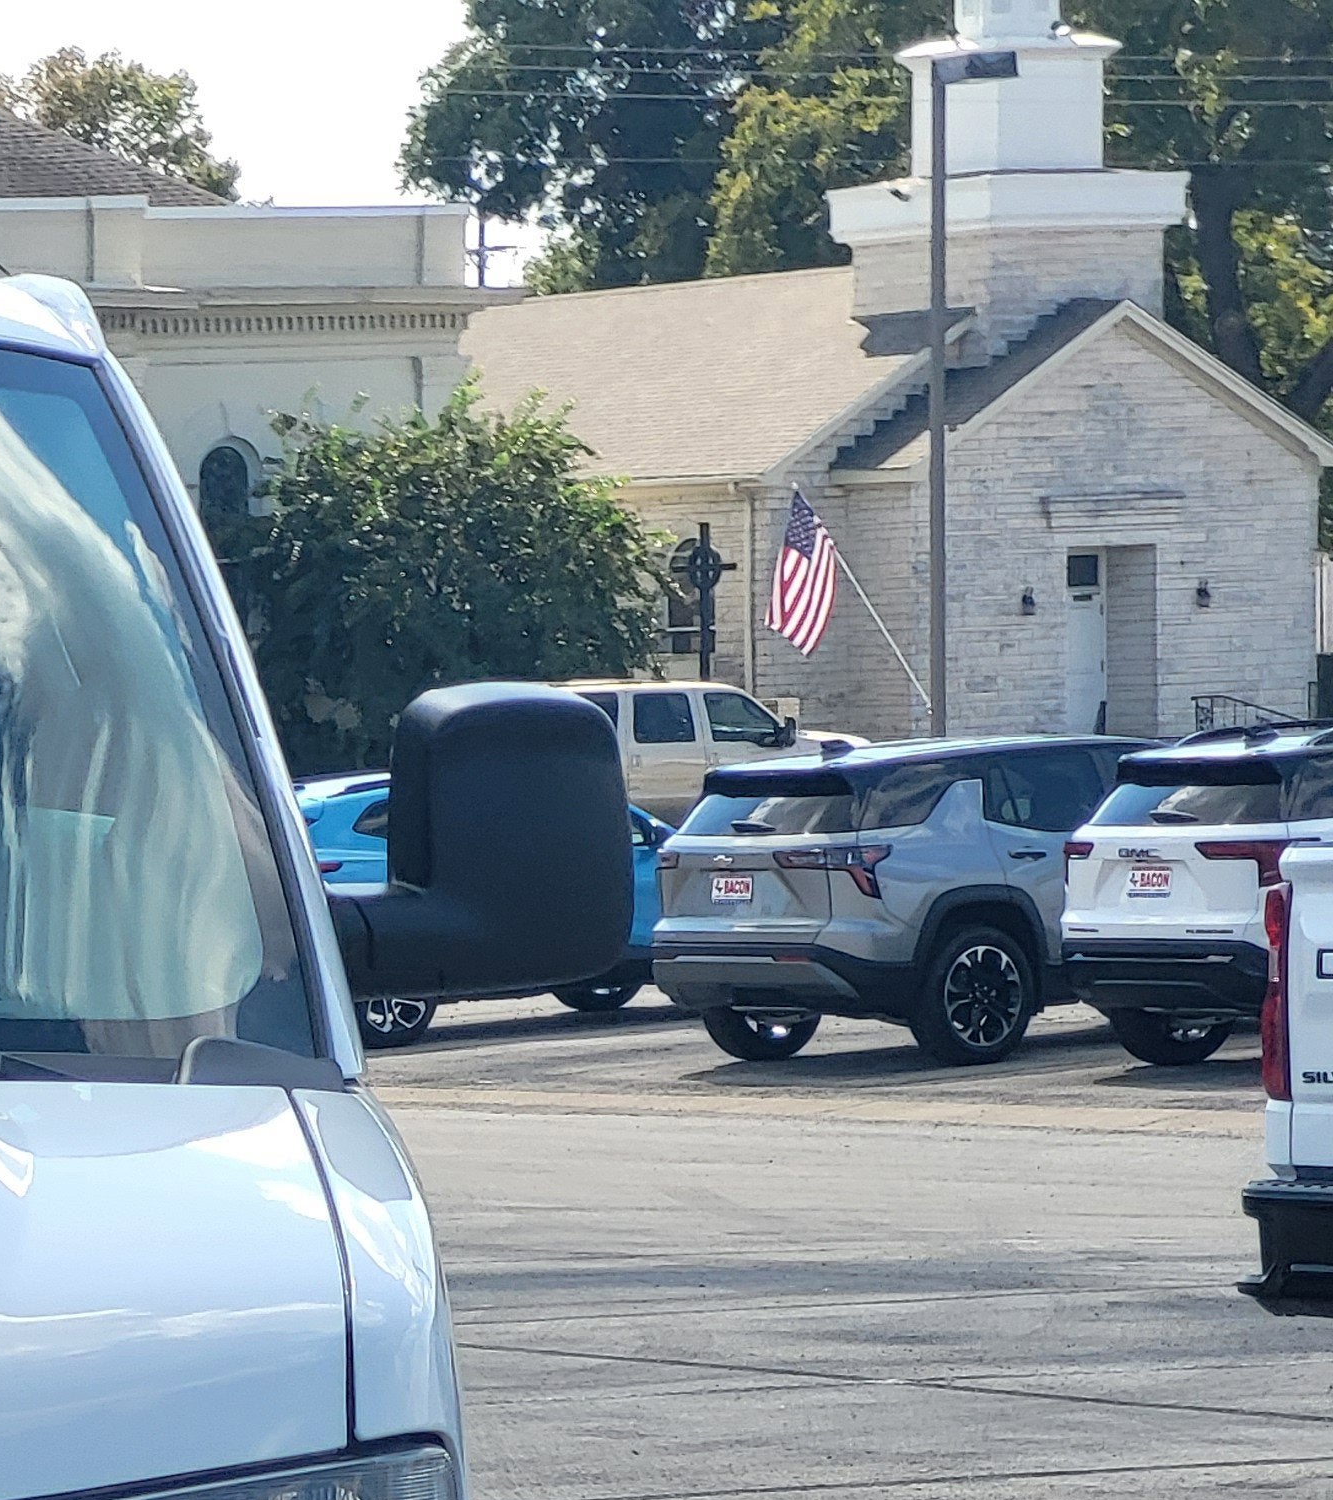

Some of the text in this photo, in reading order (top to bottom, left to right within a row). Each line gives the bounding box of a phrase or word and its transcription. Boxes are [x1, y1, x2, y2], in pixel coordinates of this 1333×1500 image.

[1118, 848, 1160, 858] GMC
[1139, 872, 1170, 887] BACON
[1302, 1071, 1333, 1084] SIL
